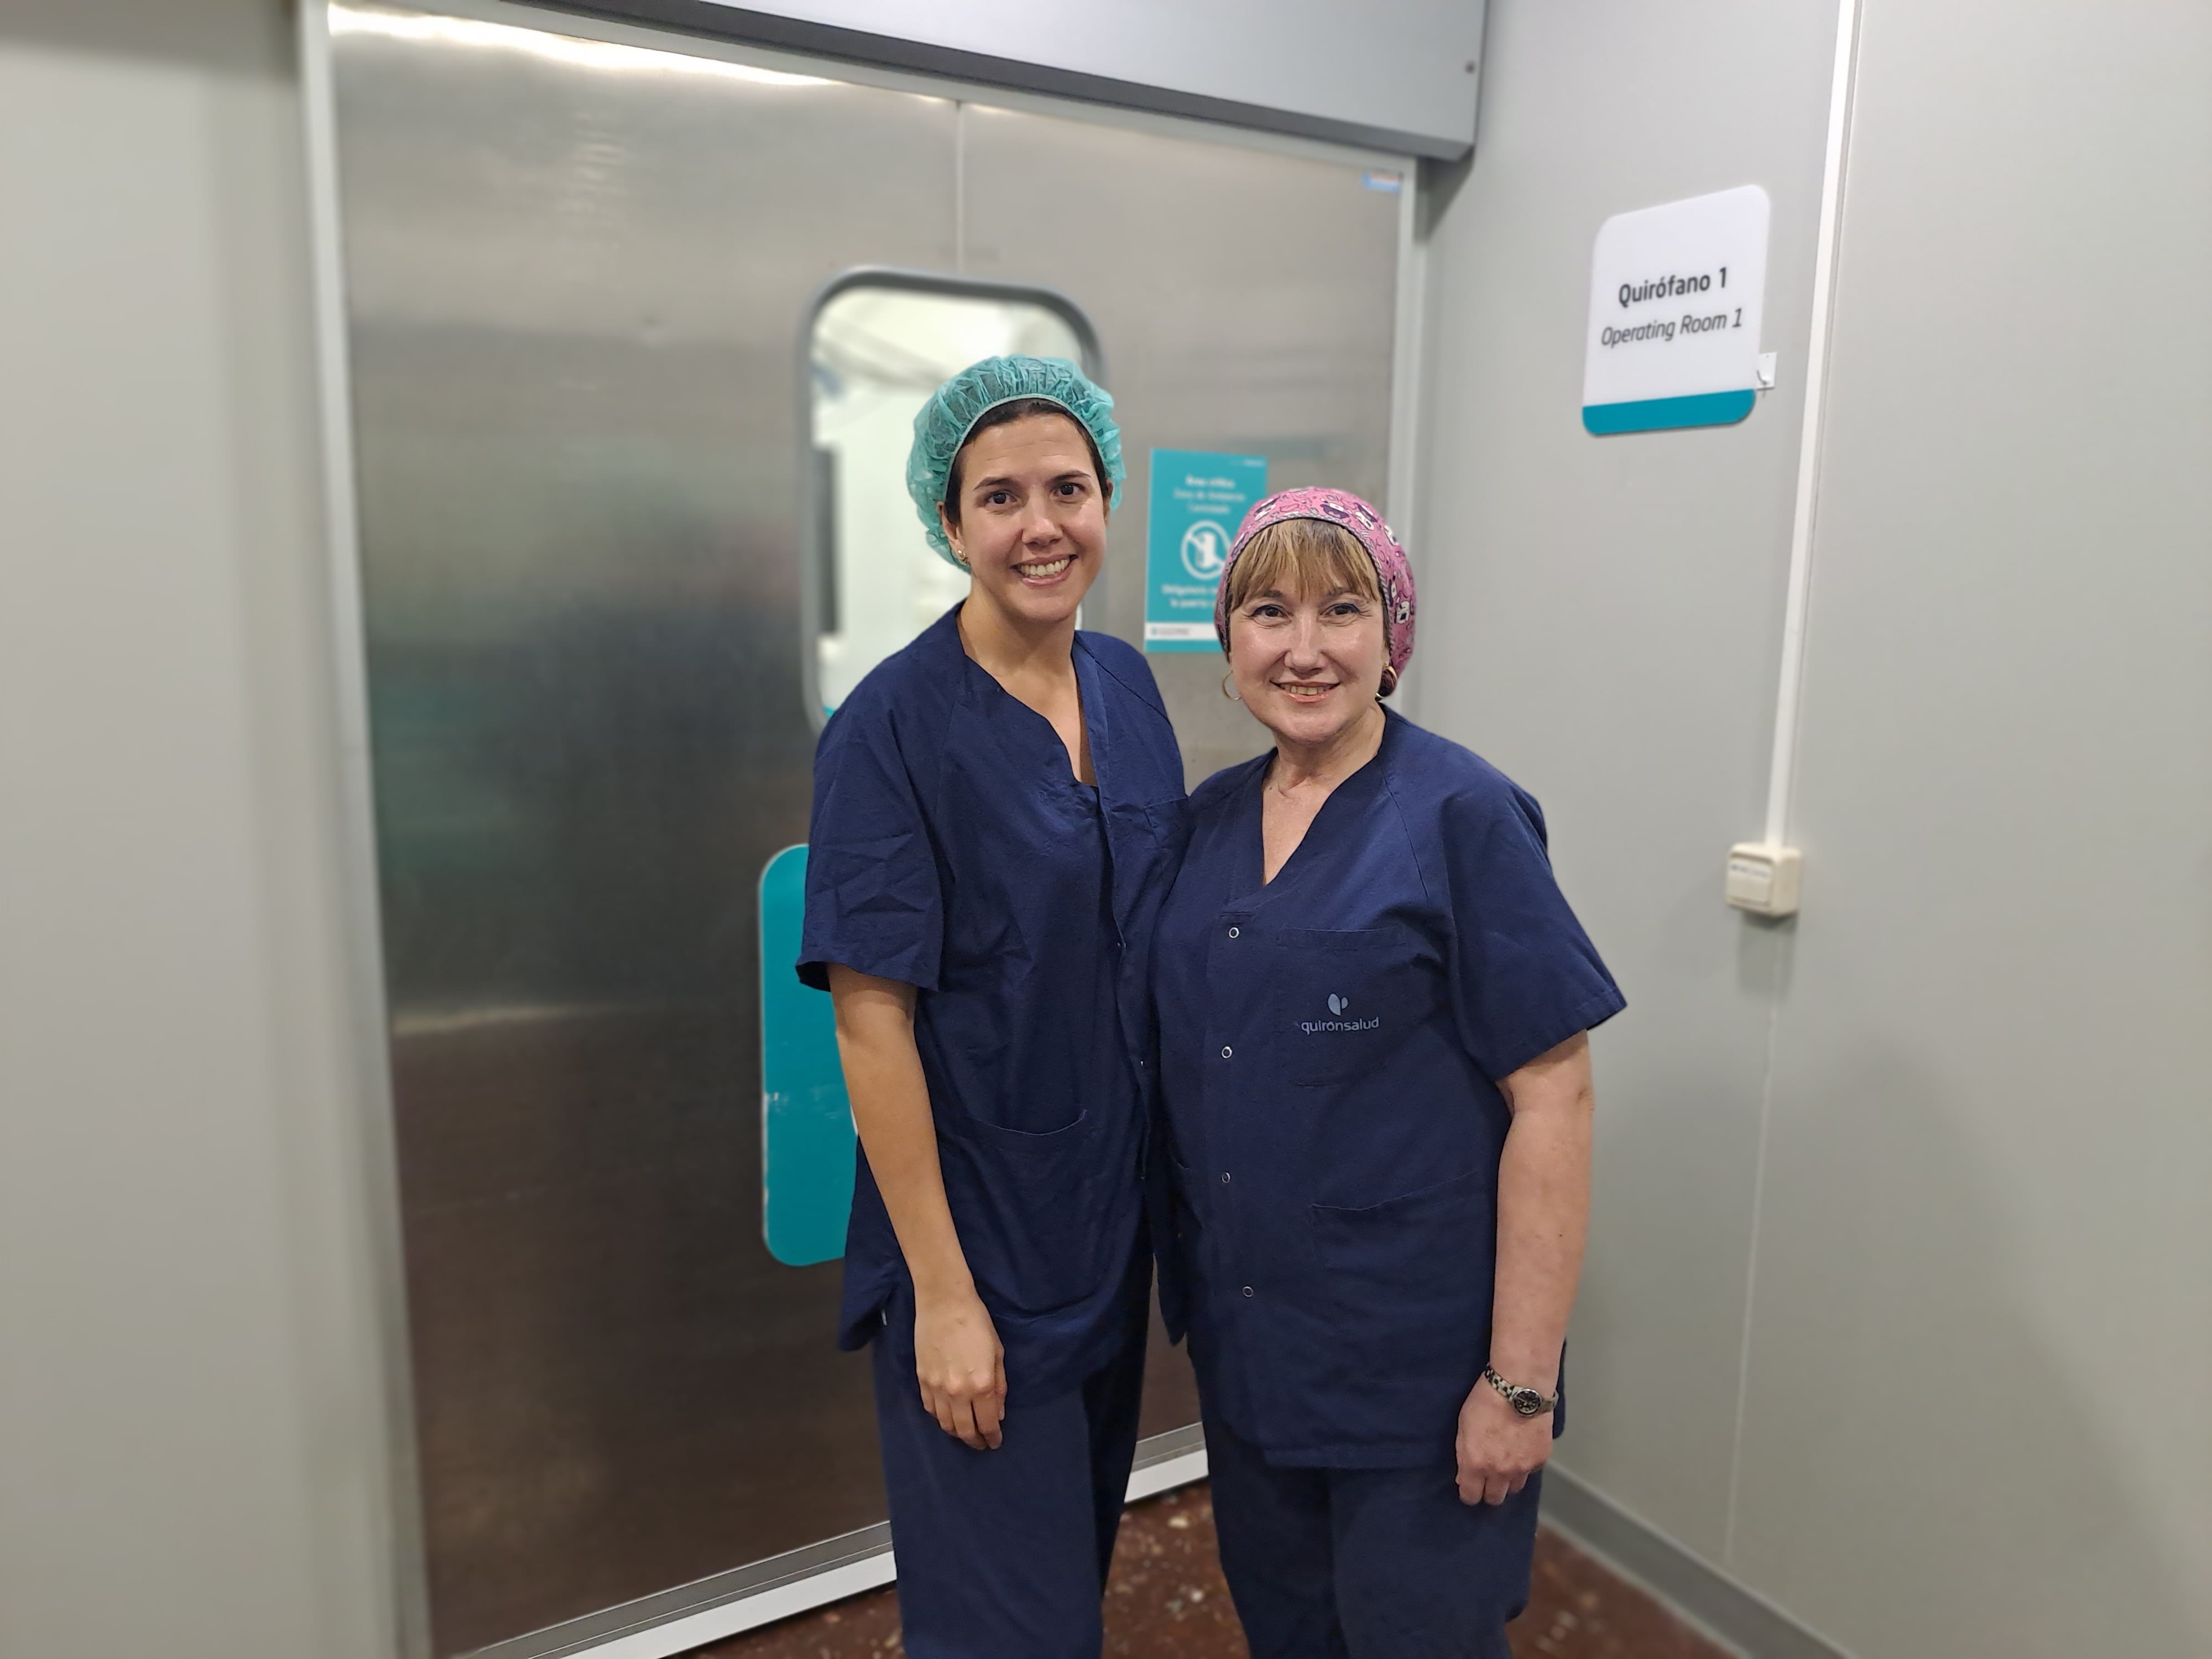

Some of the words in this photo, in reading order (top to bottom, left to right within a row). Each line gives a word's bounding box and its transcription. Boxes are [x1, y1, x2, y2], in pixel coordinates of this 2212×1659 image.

[1618, 273, 1711, 309] Quirófano
[1718, 267, 1728, 289] 1
[1601, 319, 1676, 349] Operating
[1679, 314, 1728, 336] Room
[1731, 307, 1743, 328] 1
